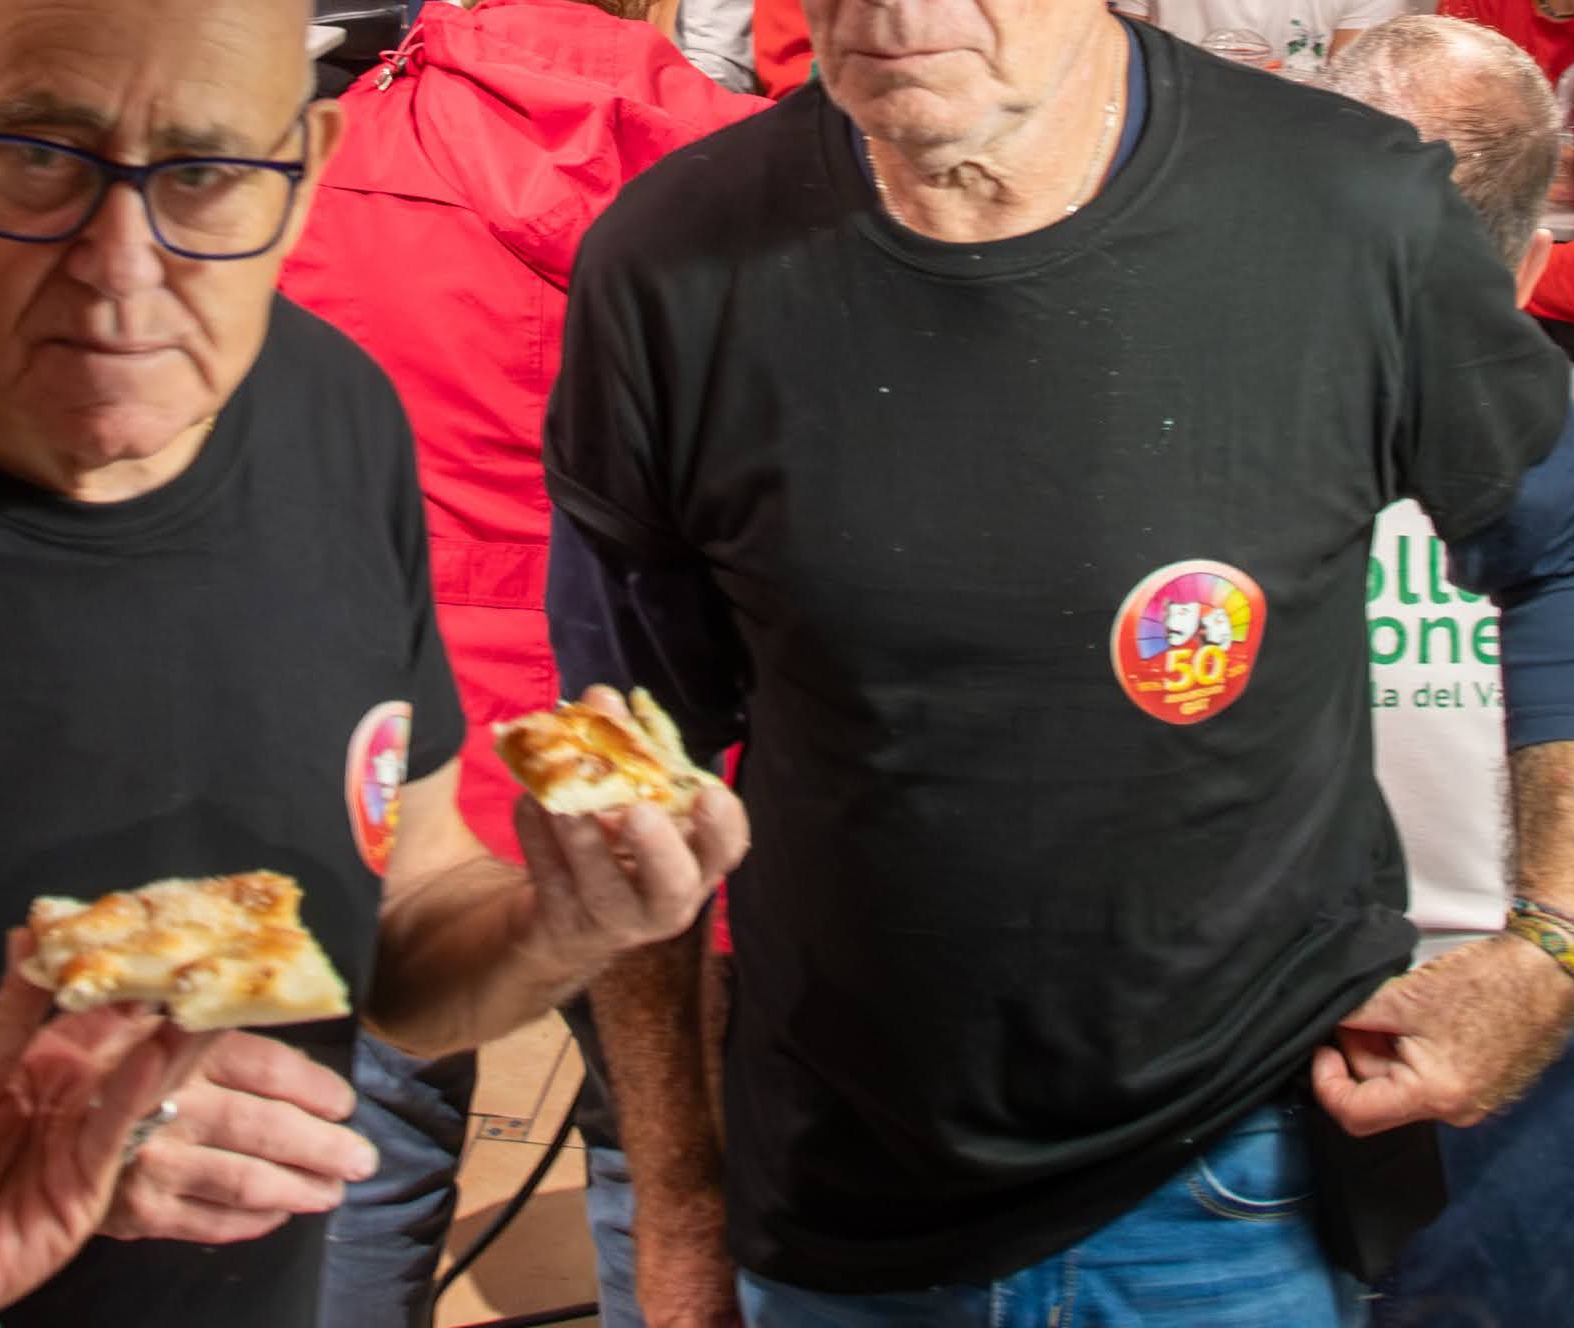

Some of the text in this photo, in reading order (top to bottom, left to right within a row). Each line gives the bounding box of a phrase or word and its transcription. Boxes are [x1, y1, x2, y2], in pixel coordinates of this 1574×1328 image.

[1368, 616, 1500, 664] one
[1164, 644, 1226, 693] 50
[1370, 681, 1399, 708] la
[1412, 681, 1465, 708] del
